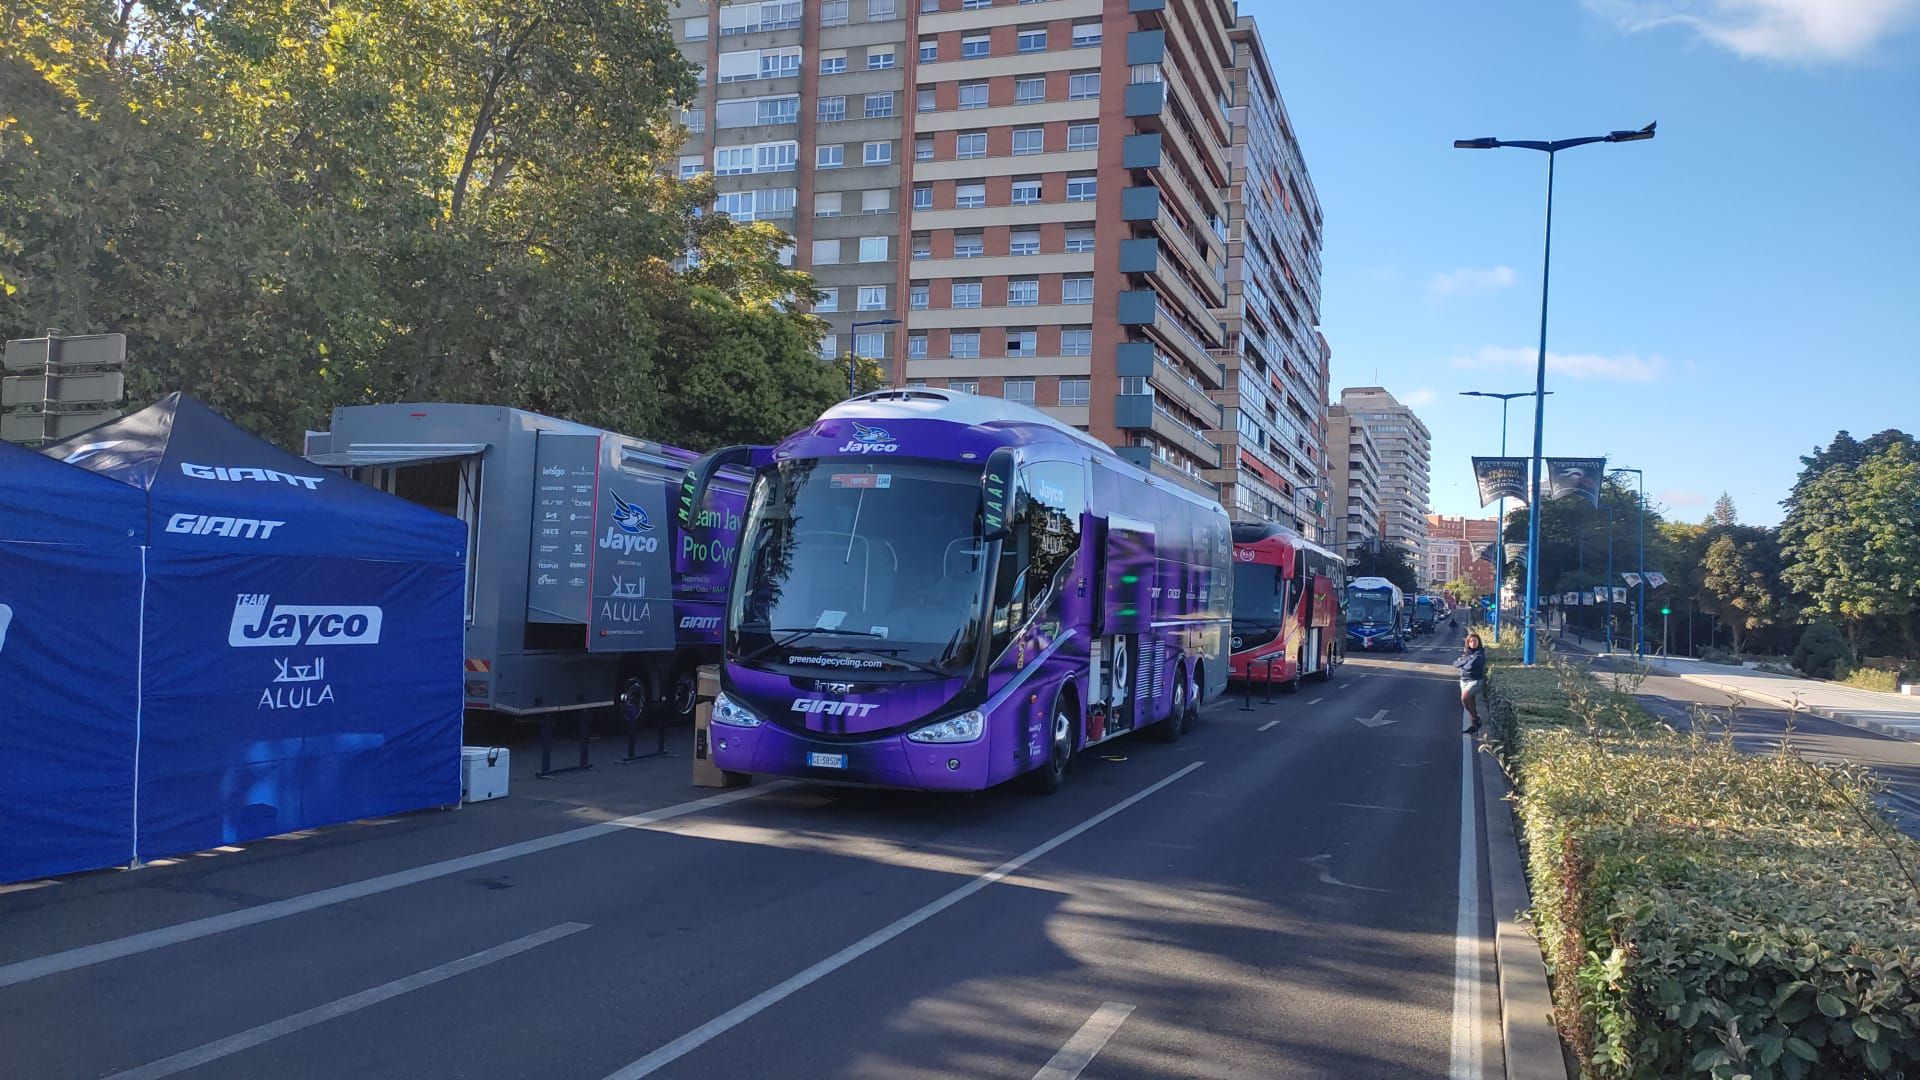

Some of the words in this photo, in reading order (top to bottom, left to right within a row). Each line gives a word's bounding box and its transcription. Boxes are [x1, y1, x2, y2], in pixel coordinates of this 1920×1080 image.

[839, 441, 898, 454] Jayco
[180, 462, 325, 490] GIANT
[678, 471, 698, 521] MAAP
[986, 473, 1004, 528] MAAP
[1040, 480, 1064, 503] Jayco
[165, 513, 286, 539] GIANT
[599, 527, 658, 556] Jayco
[683, 536, 708, 561] Pro
[237, 594, 270, 606] TEAM
[600, 600, 651, 622] ALULA
[243, 602, 369, 645] Jayco
[680, 616, 721, 629] GIANT
[789, 655, 882, 669] greenedgecycling.com
[258, 684, 335, 709] ALULA
[791, 698, 880, 717] GIANT
